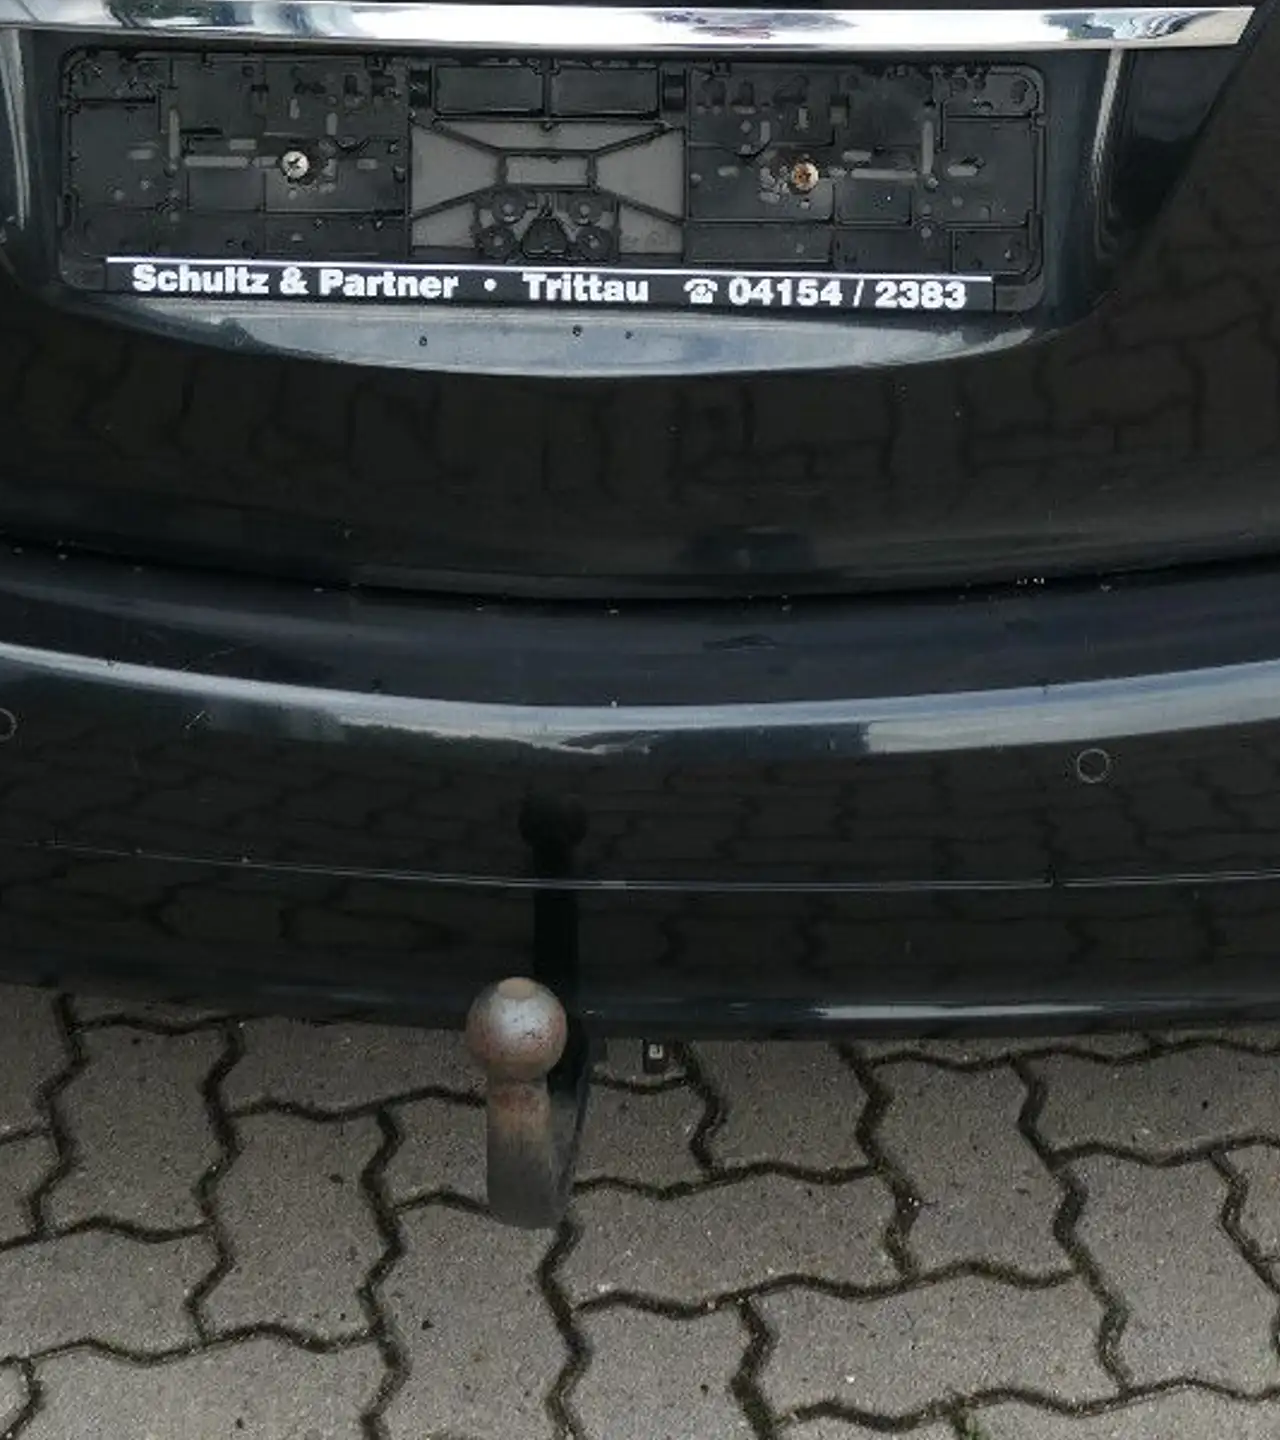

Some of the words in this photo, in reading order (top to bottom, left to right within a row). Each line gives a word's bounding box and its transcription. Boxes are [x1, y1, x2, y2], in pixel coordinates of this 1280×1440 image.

[132, 264, 270, 294] Schultz
[279, 266, 309, 295] &
[320, 268, 460, 298] Partner
[522, 273, 649, 302] Trittau
[728, 277, 843, 307] 04154
[874, 280, 968, 309] 2383
